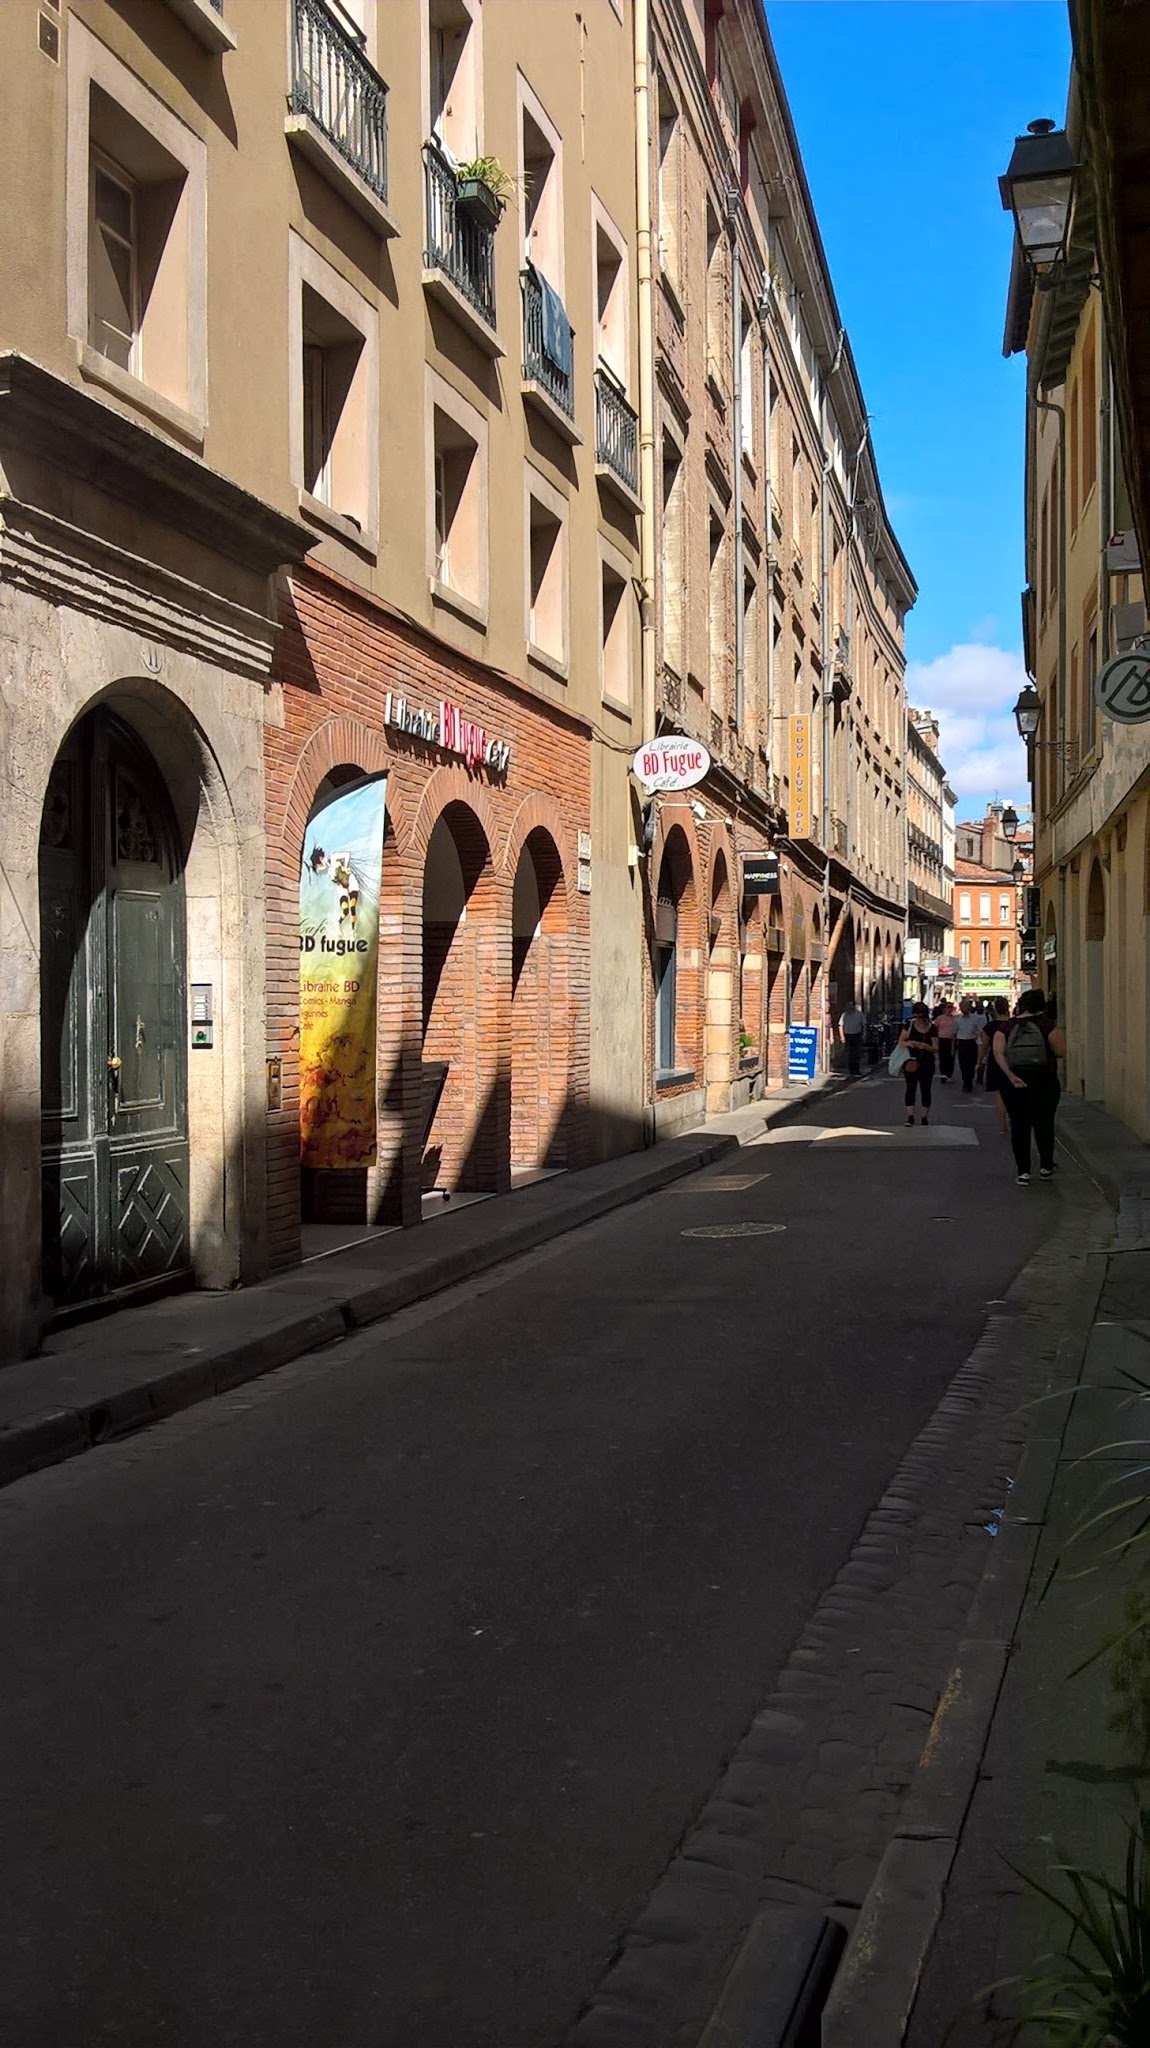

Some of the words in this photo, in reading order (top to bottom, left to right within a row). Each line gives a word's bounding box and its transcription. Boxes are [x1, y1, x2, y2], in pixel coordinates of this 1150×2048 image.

[796, 719, 804, 733] BD
[649, 741, 689, 752] Librairie
[796, 738, 804, 758] DVD
[643, 753, 659, 776] BD
[663, 751, 702, 777] Fugue
[796, 766, 804, 793] JEUX
[321, 935, 368, 956] fugue
[344, 980, 361, 993] BD
